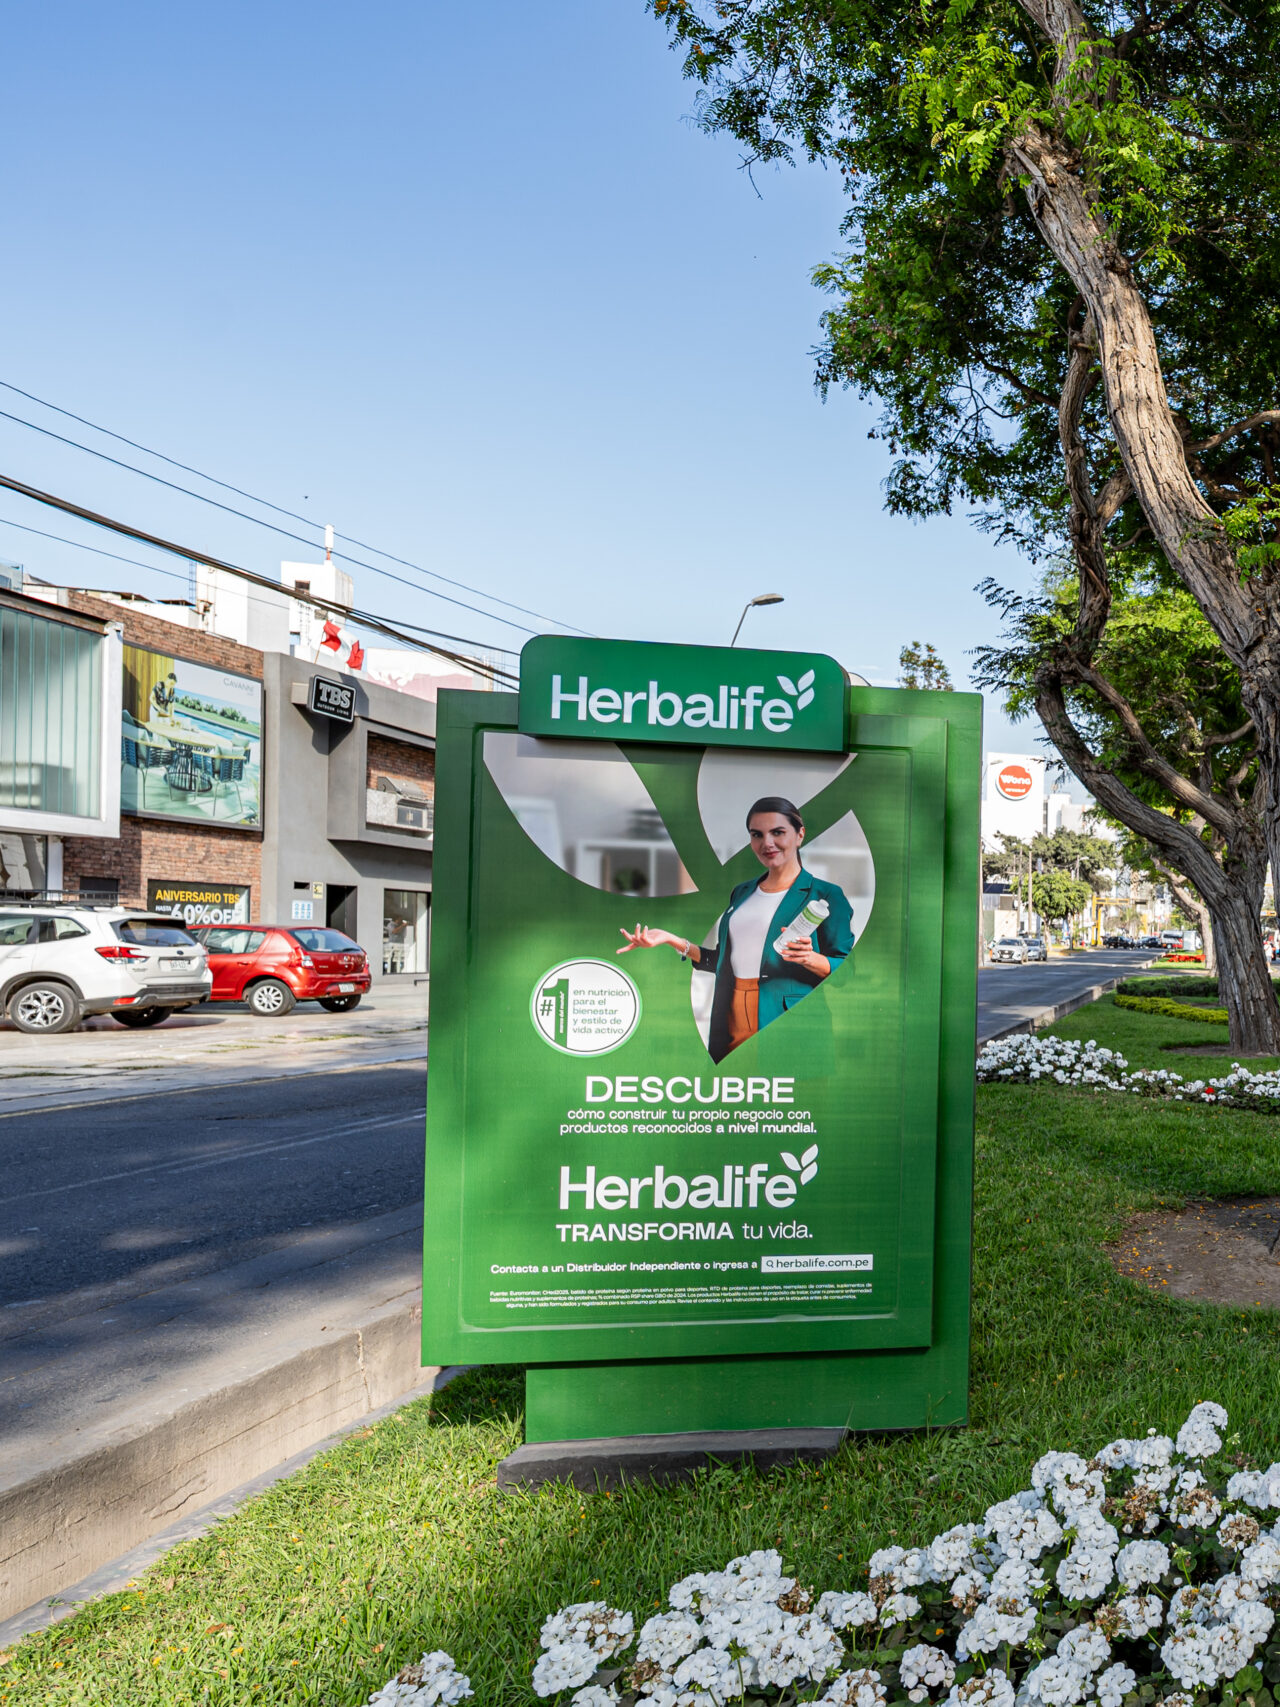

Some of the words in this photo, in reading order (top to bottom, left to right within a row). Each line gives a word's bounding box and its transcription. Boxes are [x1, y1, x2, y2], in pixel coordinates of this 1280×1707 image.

[319, 682, 351, 709] TBS
[317, 702, 336, 712] OUTDOOR
[550, 674, 794, 733] Herbalife
[156, 890, 222, 903] ANIVERSARIO
[222, 892, 240, 904] TBS
[588, 988, 630, 996] nutrición
[572, 1018, 578, 1026] y
[572, 1026, 592, 1034] vida
[586, 1076, 794, 1104] DESCUBRE
[568, 1108, 605, 1120] cómo
[609, 1109, 666, 1120] construir
[672, 1110, 685, 1120] tu
[689, 1109, 730, 1122] propio
[734, 1109, 784, 1122] negocio
[788, 1110, 811, 1120] con
[560, 1122, 628, 1136] productos
[632, 1122, 712, 1134] reconocidos
[716, 1124, 724, 1133] a
[728, 1122, 758, 1133] nivel
[762, 1122, 817, 1133] mundial.
[559, 1164, 796, 1210] Herbalife
[556, 1222, 734, 1242] TRANSFORMA
[742, 1224, 764, 1240] tu
[768, 1220, 814, 1239] vida.
[490, 1264, 538, 1274] Contacta
[567, 1262, 627, 1272] Distribuidor
[630, 1262, 701, 1273] Independiente
[713, 1261, 748, 1271] ingresa
[776, 1258, 869, 1269] herbalife.com.pe
